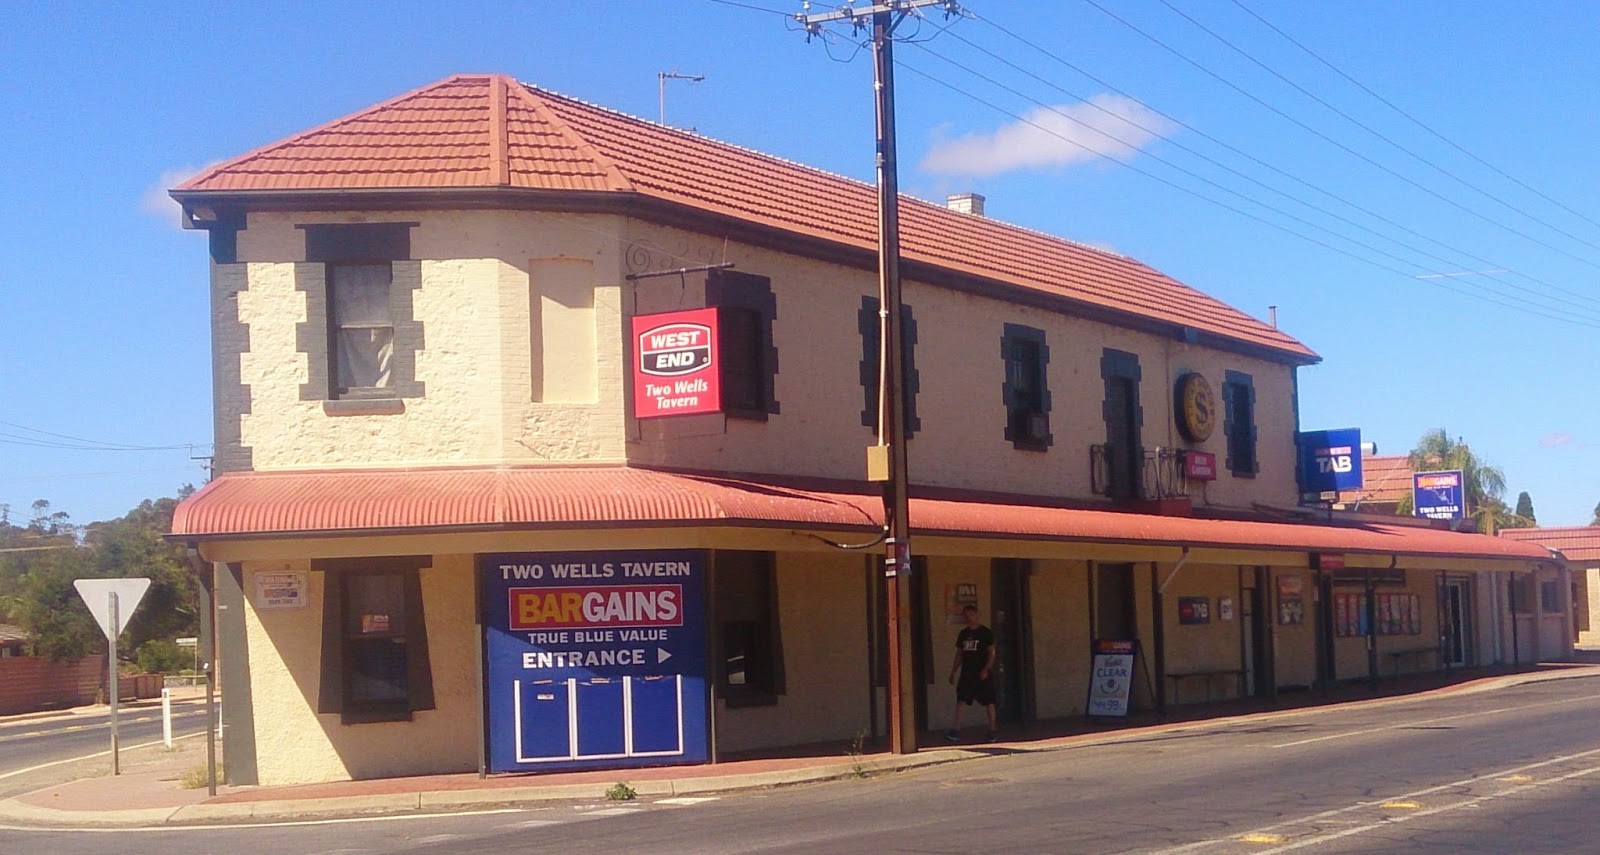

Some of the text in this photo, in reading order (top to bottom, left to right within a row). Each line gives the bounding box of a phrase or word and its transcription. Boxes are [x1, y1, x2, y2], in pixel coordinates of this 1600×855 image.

[650, 331, 701, 349] WEST
[655, 352, 695, 369] END
[645, 379, 708, 397] Two Wells
[656, 396, 698, 409] Tavern
[1316, 455, 1352, 473] TAB
[1436, 505, 1459, 513] WELLS
[499, 561, 691, 580] TWO WELLS TAVERN
[518, 590, 677, 624] BARGAINS
[528, 629, 668, 645] TRUE BLUE VALUE
[523, 649, 645, 669] ENTRANCE
[1097, 668, 1127, 678] CLEAR
